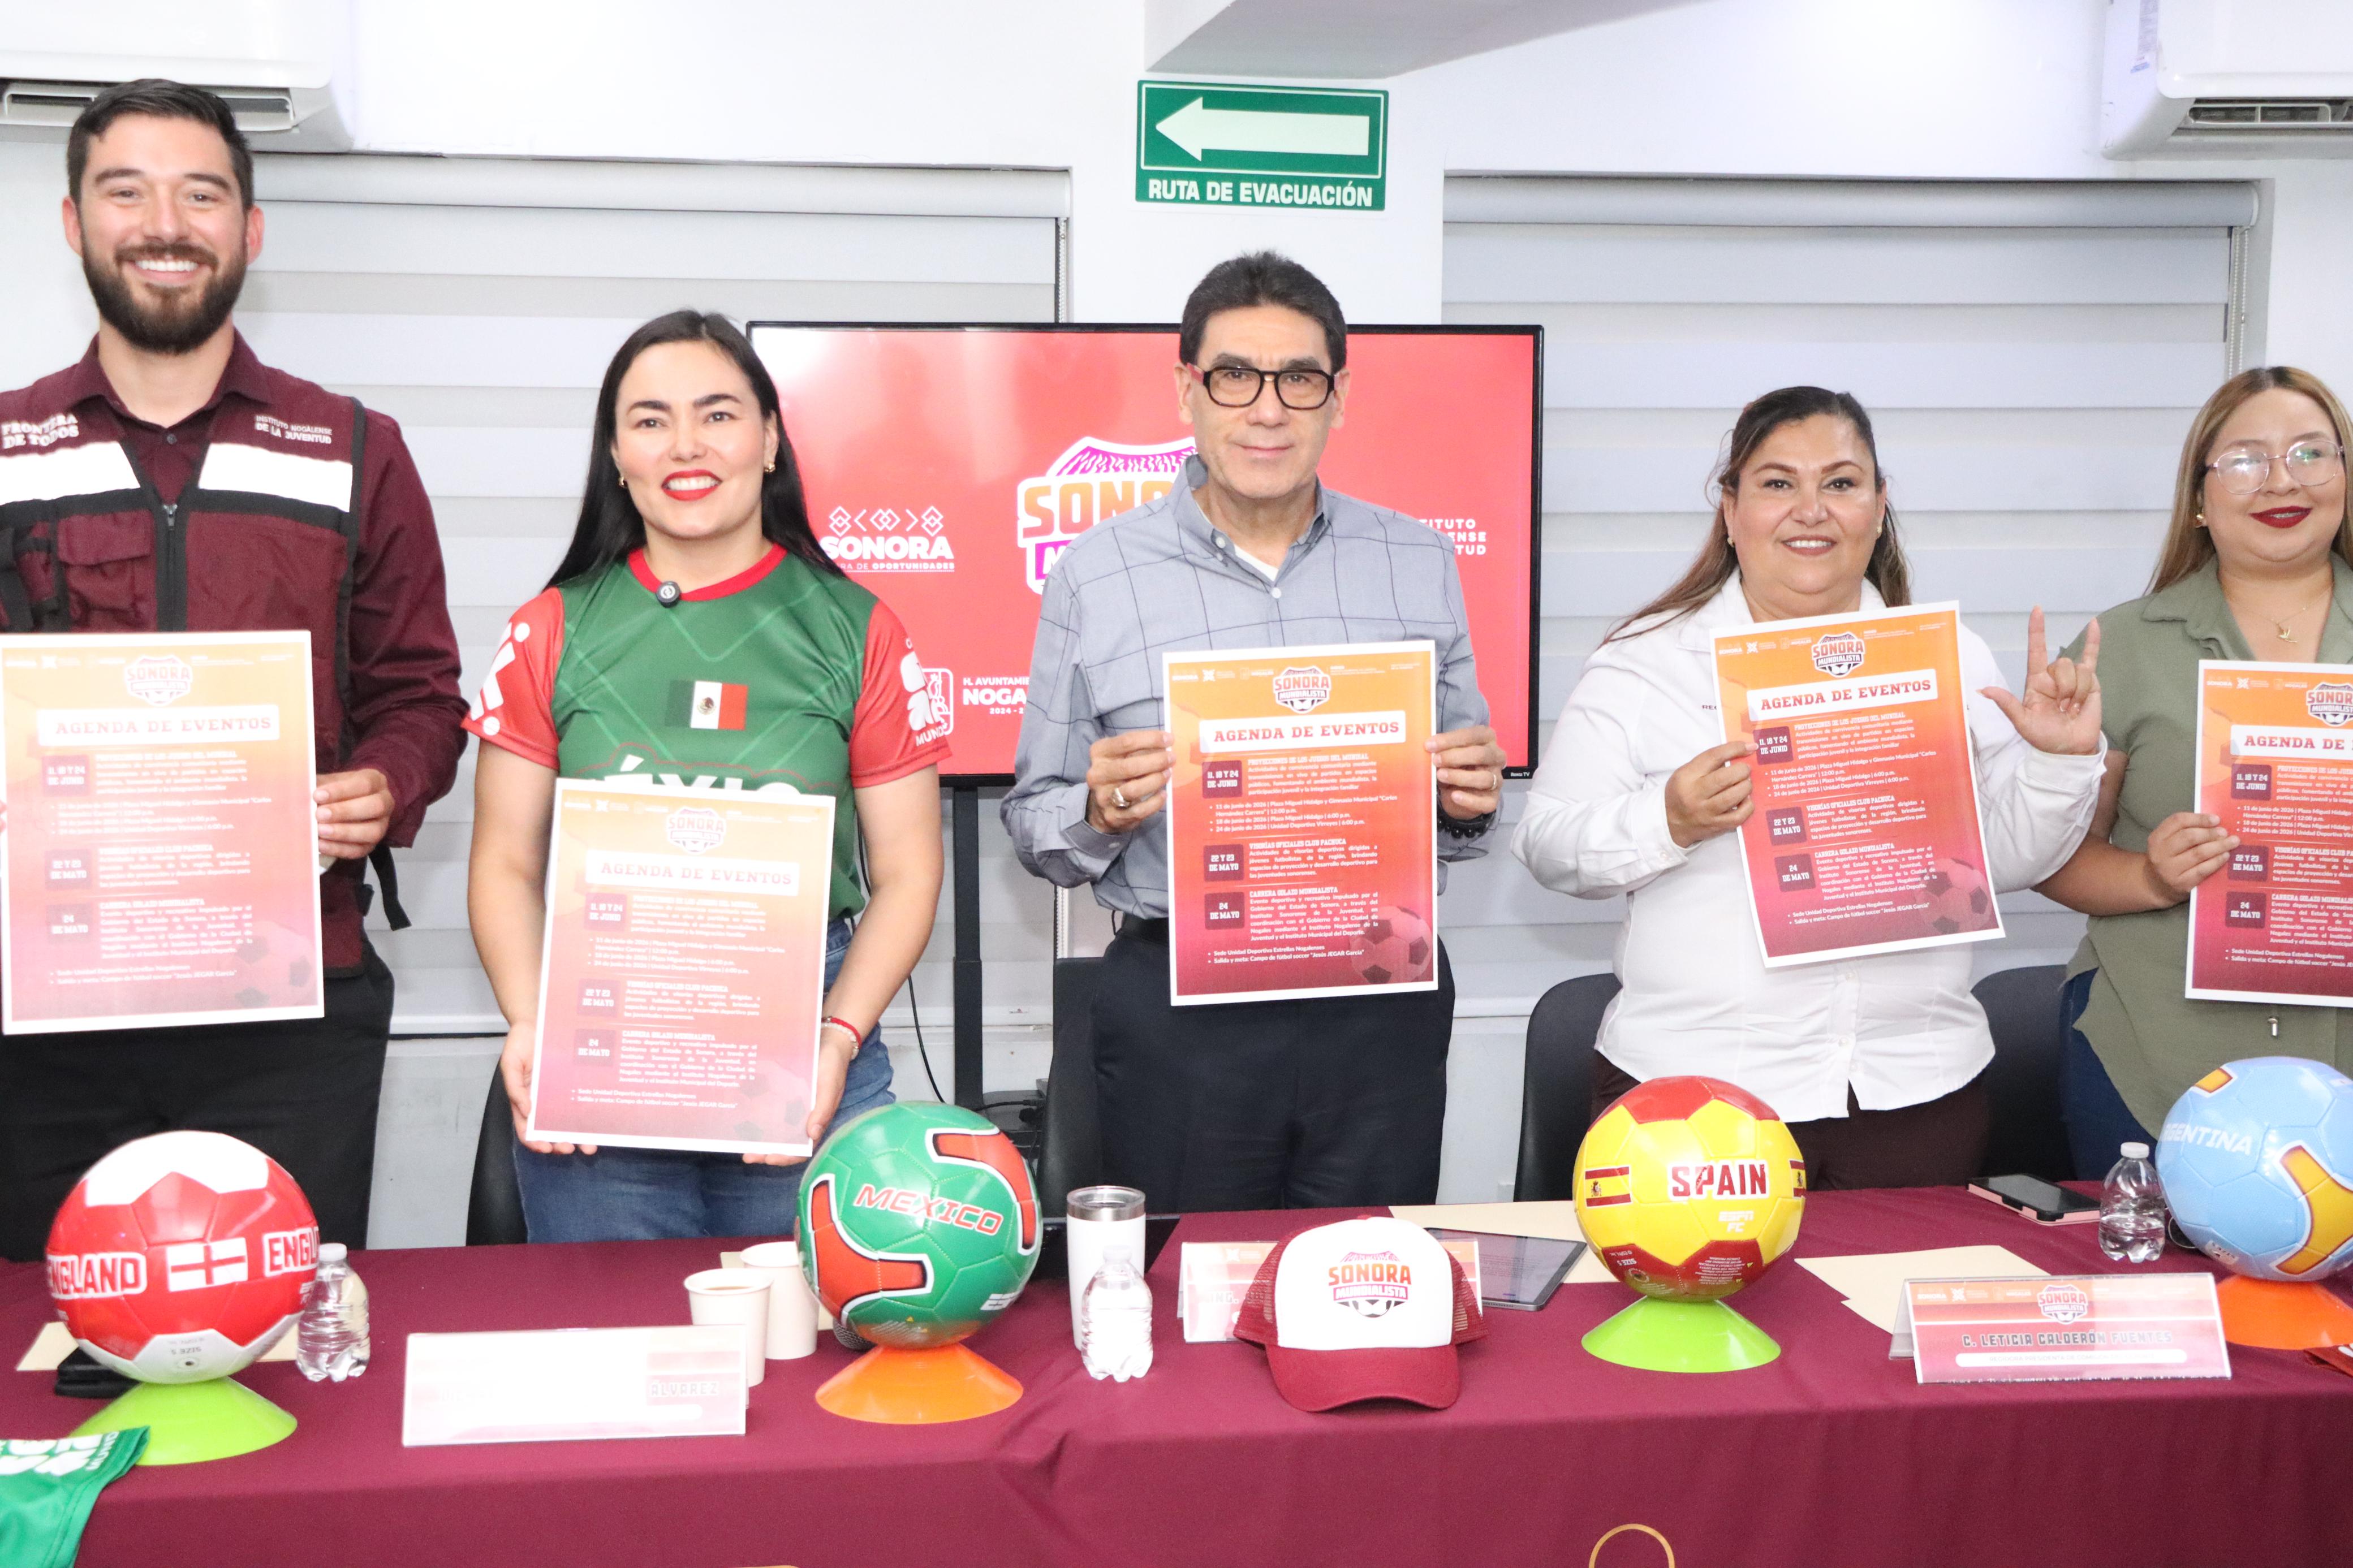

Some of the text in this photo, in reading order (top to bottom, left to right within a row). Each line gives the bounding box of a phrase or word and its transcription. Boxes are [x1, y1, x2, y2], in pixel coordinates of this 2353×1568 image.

[1149, 179, 1372, 207] RUTA DE EVACUACIÓN
[2, 413, 78, 435] FRONTERA
[256, 415, 332, 435] INSTITUTO NOGALENSE
[3, 425, 79, 449] DE TODOS
[256, 422, 331, 444] DE LA JUVENTUD
[820, 536, 954, 560] SONORA
[1812, 640, 1864, 658] SONORA
[1817, 653, 1860, 666] MUNDIALISTA
[127, 666, 190, 680] SONORA
[975, 677, 1029, 685] AYUNTAMIE
[1274, 676, 1329, 690] SONORA
[963, 688, 1027, 705] NOGA
[1279, 690, 1325, 699] MUNDIALISTA
[1760, 679, 1931, 710] AGENDA DE EVENTOS
[2307, 691, 2352, 704] SONOR
[55, 717, 271, 735] AGENDA DE EVENTOS
[1213, 722, 1399, 742] AGENDA DE EVENTOS
[2244, 735, 2344, 749] AGENDA DE
[667, 815, 725, 832] SONORA
[1782, 826, 1800, 834] MAYO
[601, 862, 791, 884] AGENDA DE EVENTOS
[1791, 872, 1809, 880] MAYO
[1671, 1164, 1766, 1196] SPAIN
[854, 1184, 1003, 1235] MEXICO
[1727, 1222, 1744, 1232] FC
[1329, 1263, 1411, 1286] SONORA
[1335, 1285, 1406, 1299] MUNDIALISTA
[2039, 1291, 2087, 1304] SONORA
[2044, 1304, 2084, 1312] MUNDIALISTA
[1963, 1331, 2172, 1347] C. LETICIA CALDERÓN FUENTES
[650, 1379, 719, 1396] ÁLVAREZ
